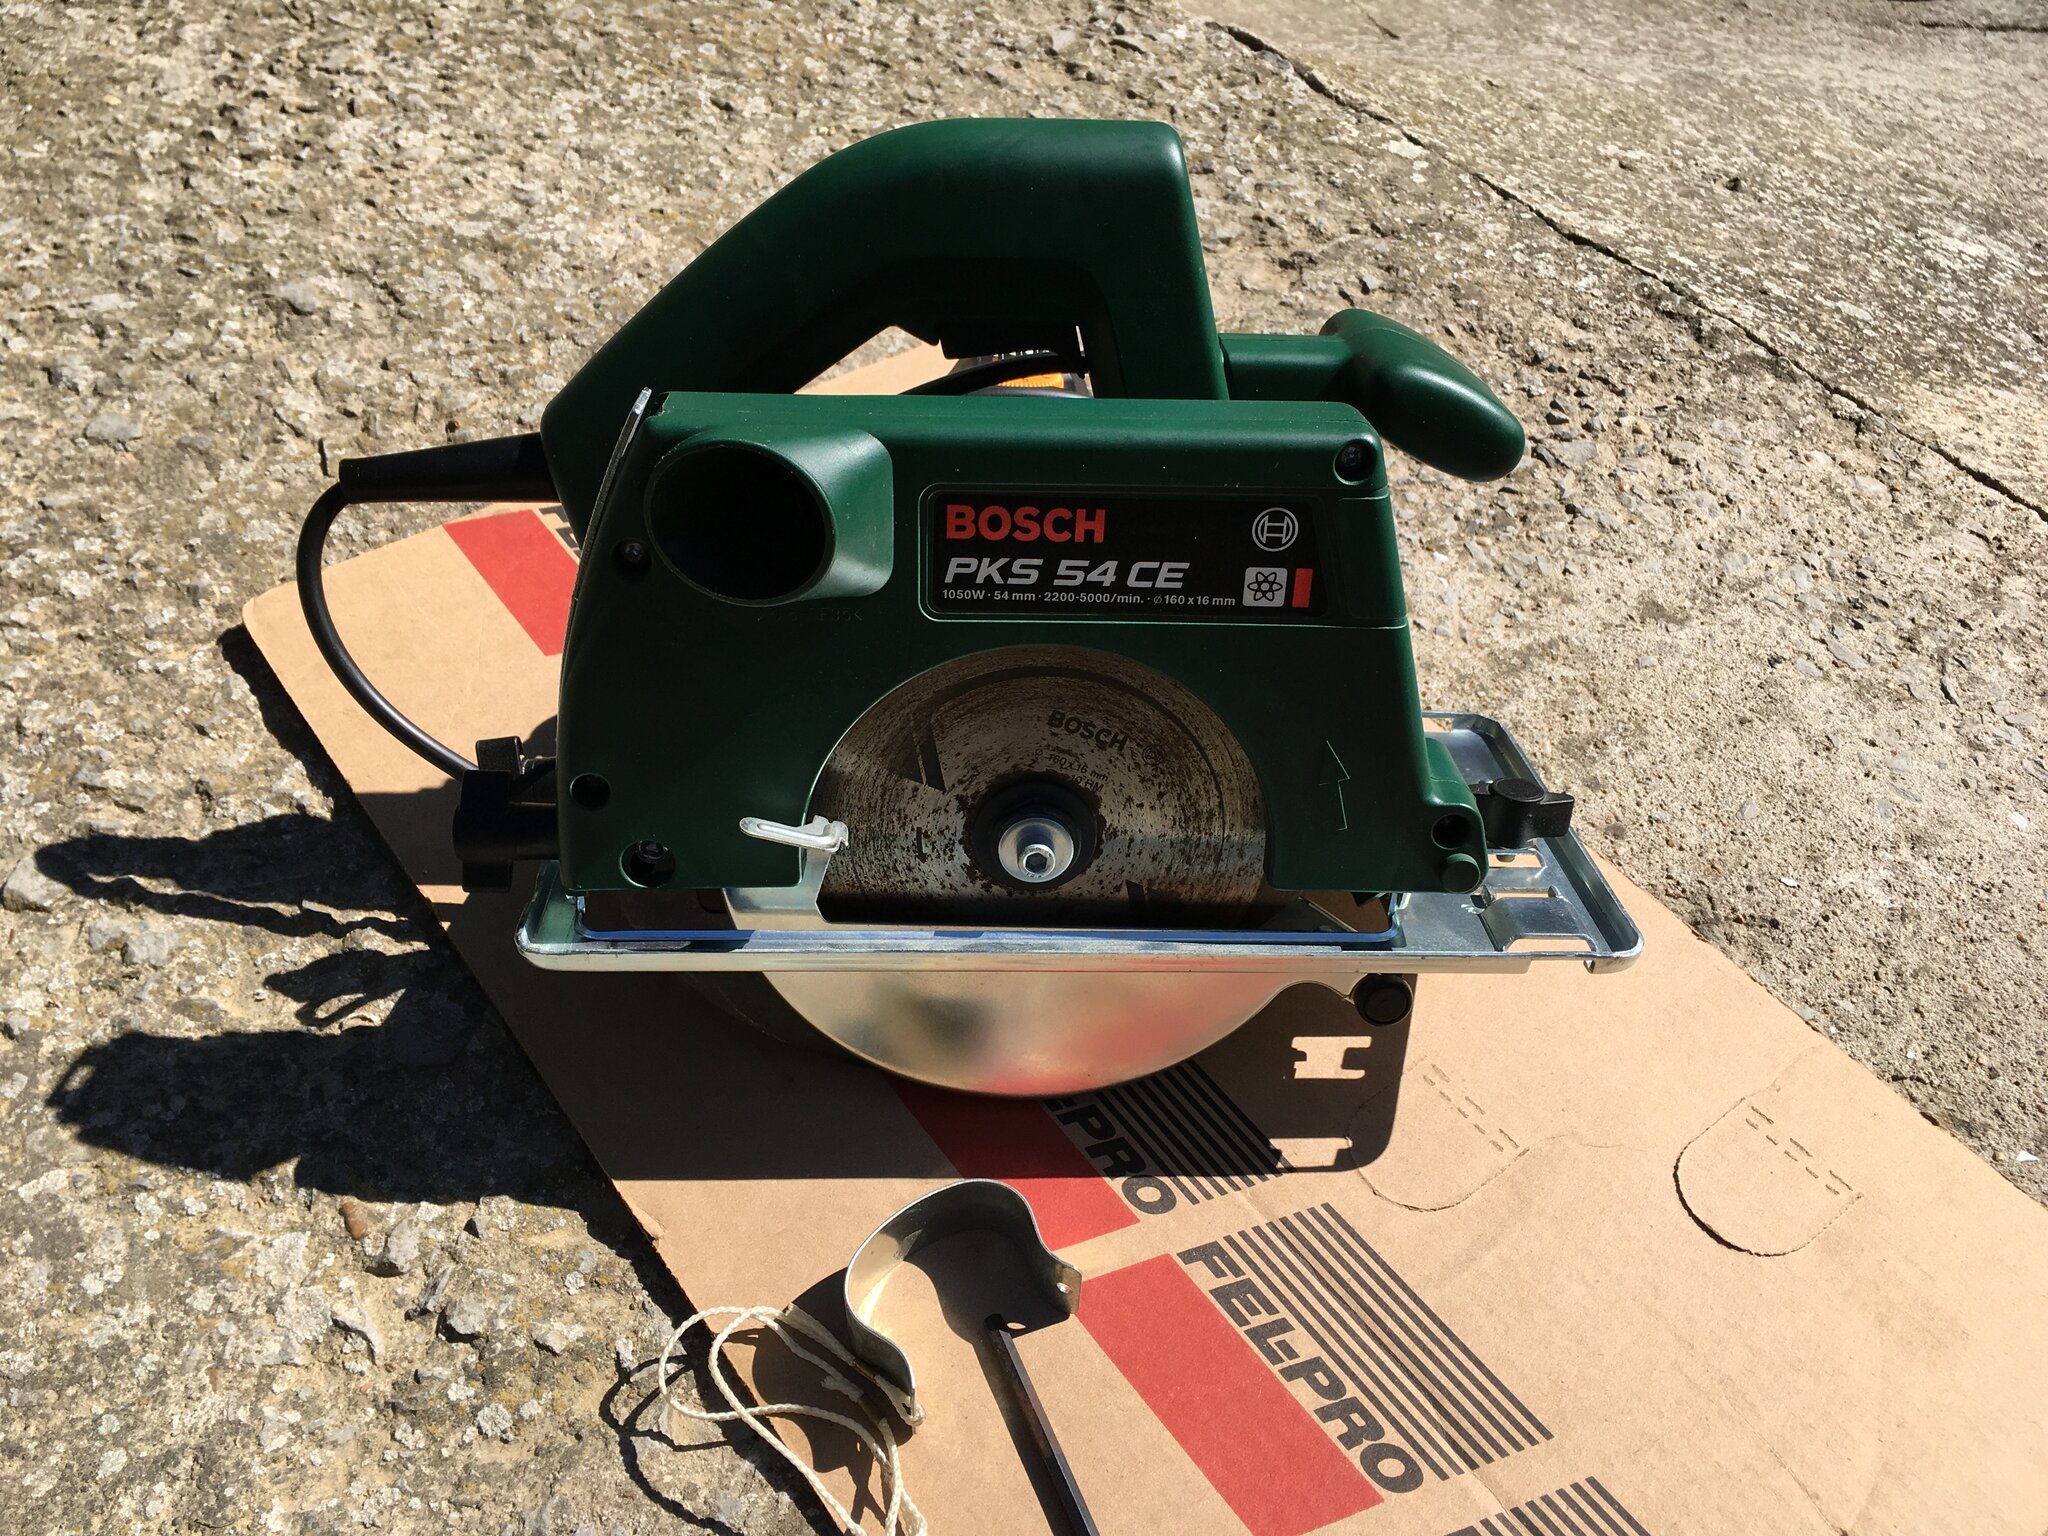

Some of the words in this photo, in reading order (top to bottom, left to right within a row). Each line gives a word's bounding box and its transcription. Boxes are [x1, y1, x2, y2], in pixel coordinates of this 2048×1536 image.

[946, 505, 1106, 543] BOSCH
[944, 557, 1044, 585] PKS
[1053, 559, 1118, 587] 54
[1126, 561, 1190, 588] CE
[942, 589, 986, 600] 1050W
[993, 591, 1009, 601] 54
[1012, 592, 1036, 601] mm
[1212, 597, 1236, 606] mm
[1047, 710, 1128, 751] BOSCH
[1176, 1240, 1424, 1494] FEL-PRO
